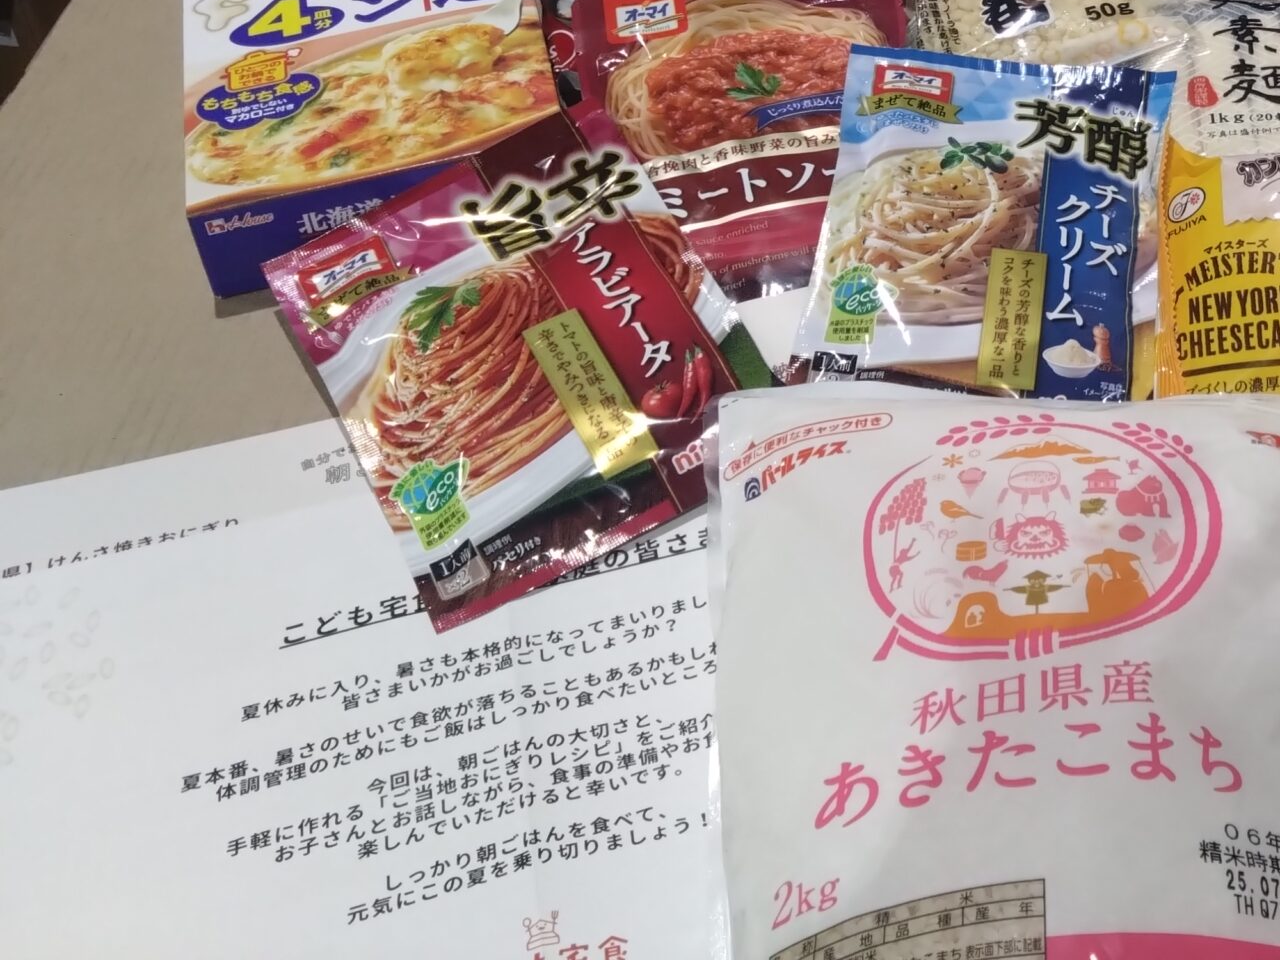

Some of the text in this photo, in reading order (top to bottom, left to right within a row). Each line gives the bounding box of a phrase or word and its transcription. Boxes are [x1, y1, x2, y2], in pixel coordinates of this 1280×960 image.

[624, 1, 670, 22] オーマイ
[1085, 2, 1135, 22] 50g
[234, 59, 282, 74] ひとつの
[238, 66, 277, 82] お鍋で
[239, 74, 277, 88] できる
[891, 70, 939, 86] オーマイ
[201, 79, 315, 111] もちもち食感
[872, 95, 948, 118] まぜて絶品
[223, 103, 295, 124] マカロニ付き
[1014, 98, 1154, 180] 芳醇
[460, 150, 642, 260] 旨辛
[725, 221, 769, 239] enriched
[1086, 182, 1129, 277] チーズ
[1166, 214, 1208, 240] FUJIYA
[1045, 193, 1092, 327] クリーム
[1203, 238, 1270, 254] マイスターズ
[323, 251, 371, 283] オーマイ
[730, 253, 788, 274] mushrooms
[560, 221, 672, 378] アラビアータ
[845, 288, 880, 312] eco
[1187, 290, 1235, 326] NEW
[988, 255, 1018, 380] コクを味わう濃厚な一品
[1011, 257, 1037, 378] チーズの芳醇な香りと
[838, 334, 862, 343] しました
[817, 353, 852, 374] 1人前
[730, 416, 883, 475] 保存に便利なチャック付き
[760, 440, 849, 492] パールライス
[425, 470, 456, 511] eco
[439, 547, 473, 577] 1人前
[911, 659, 1155, 735] 秋田県産
[215, 659, 718, 802] 体調管理のためにもご飯はしっかり食べたいところ
[366, 714, 663, 795] 今回は、朝ごはんの大切さと、
[813, 711, 1244, 830] あきたこまち
[357, 763, 683, 860] 楽しんでいただけると幸いです。
[385, 806, 667, 891] しっかり朝ごはんを食べて、
[346, 812, 709, 926] 元気にこの夏を乗り切りましょう！
[771, 877, 841, 931] 2kg
[1233, 892, 1255, 917] TH
